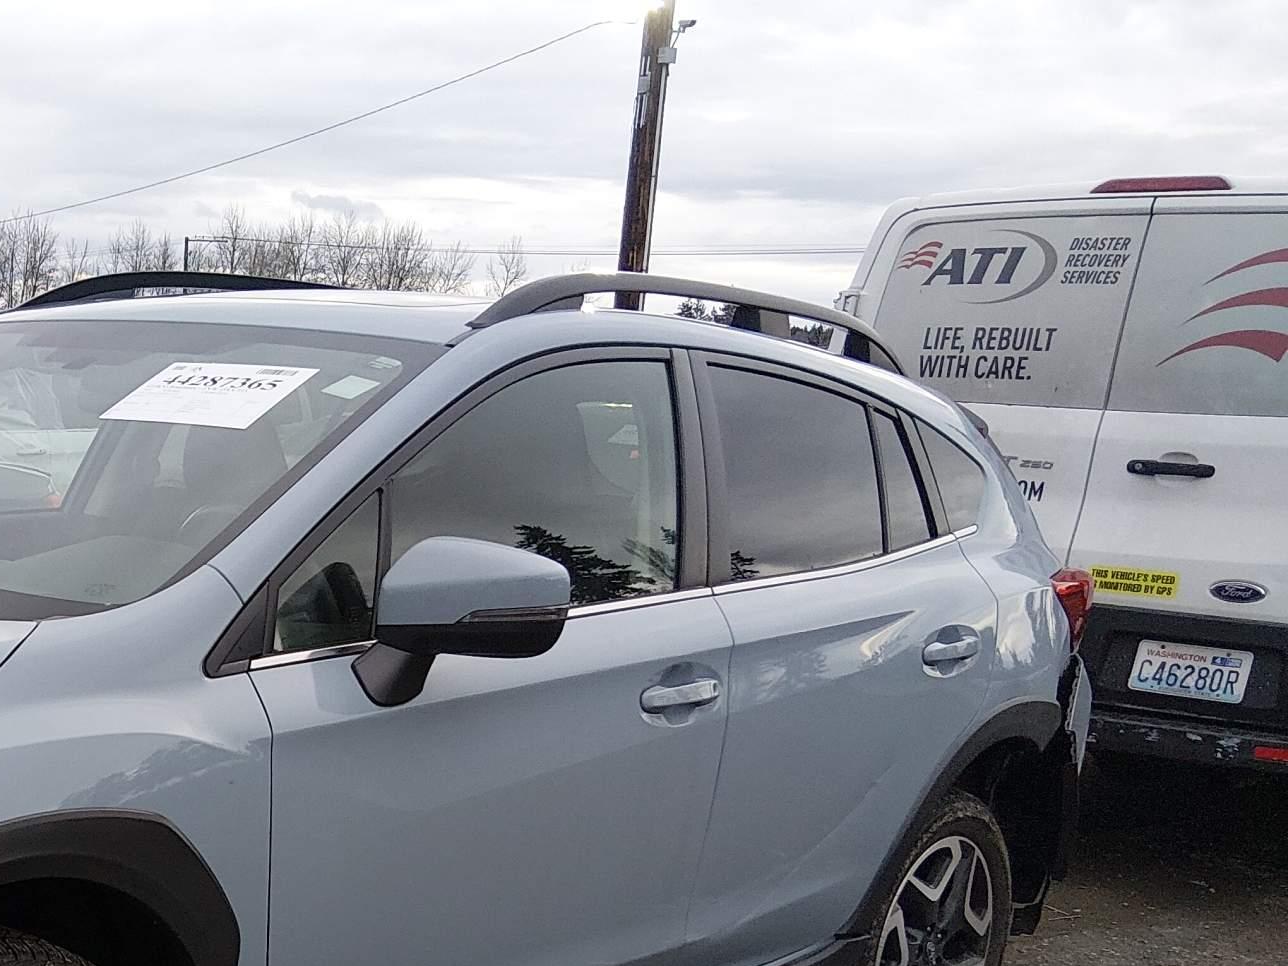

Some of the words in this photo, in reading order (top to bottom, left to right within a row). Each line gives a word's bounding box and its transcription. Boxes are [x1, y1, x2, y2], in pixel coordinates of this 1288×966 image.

[1069, 236, 1132, 251] DISASTER
[920, 246, 1028, 286] ATI
[1064, 253, 1131, 268] RECOVERY
[1060, 270, 1121, 285] SERVICES
[922, 326, 965, 353] LIFE,
[971, 327, 1058, 352] REBUILT
[918, 355, 970, 379] WITH
[974, 355, 1032, 381] CARE.
[162, 373, 284, 391] 44287365
[1092, 568, 1109, 579] THIS
[1110, 570, 1150, 583] VEHICLE'S
[1150, 574, 1176, 585] SPEED
[1098, 580, 1143, 593] MONITORED
[1143, 584, 1155, 595] BY
[1155, 586, 1173, 596] GPS
[1220, 584, 1254, 599] Ford
[1146, 648, 1208, 663] WASHINGTON
[1137, 659, 1240, 696] C46280R
